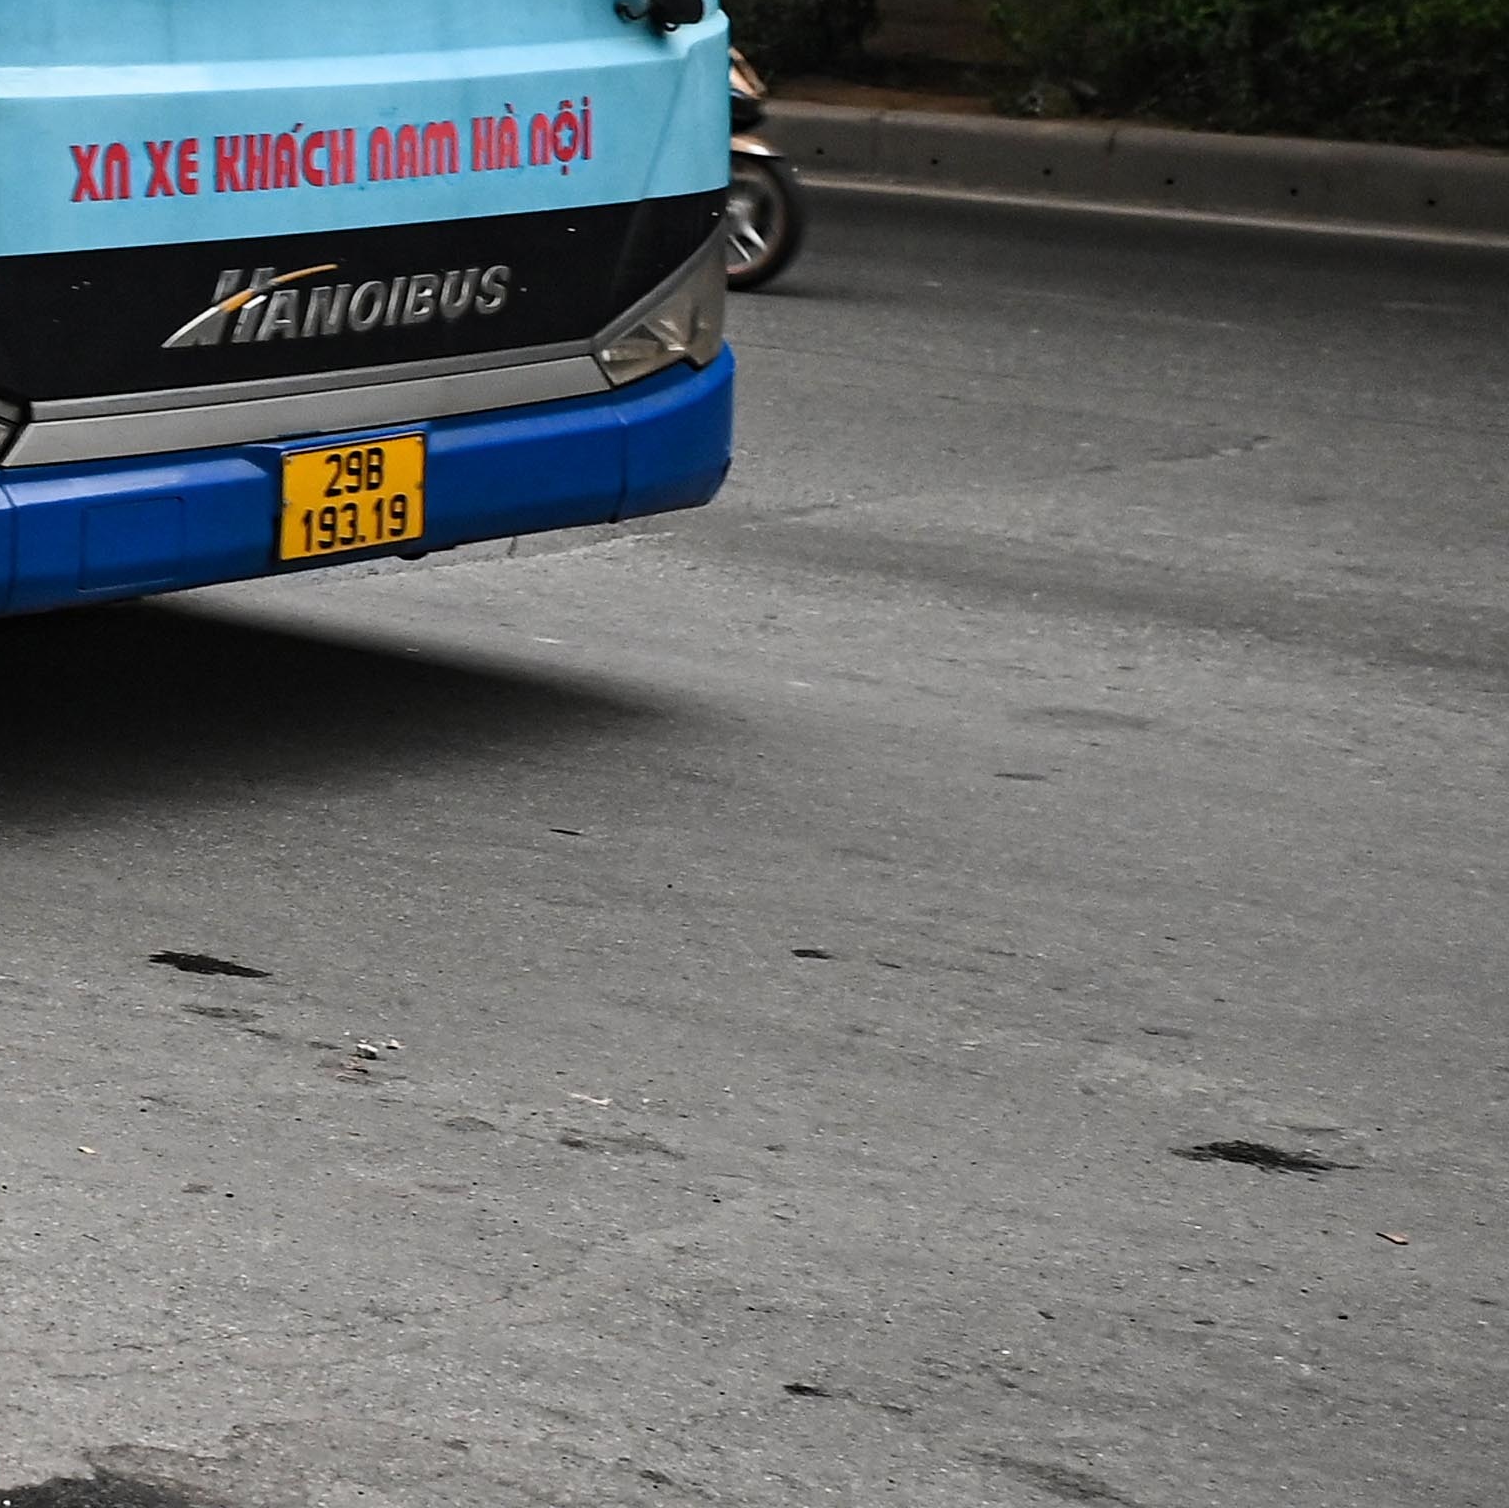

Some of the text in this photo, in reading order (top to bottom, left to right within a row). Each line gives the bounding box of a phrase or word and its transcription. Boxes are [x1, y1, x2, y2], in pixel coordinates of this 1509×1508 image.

[145, 137, 199, 197] XE
[213, 122, 356, 193] KHÁCH
[368, 120, 460, 182] NAM
[471, 102, 520, 173] HÀ
[160, 262, 513, 350] HANOIBUS
[324, 446, 385, 498] 29B
[301, 493, 408, 553] 193.19
